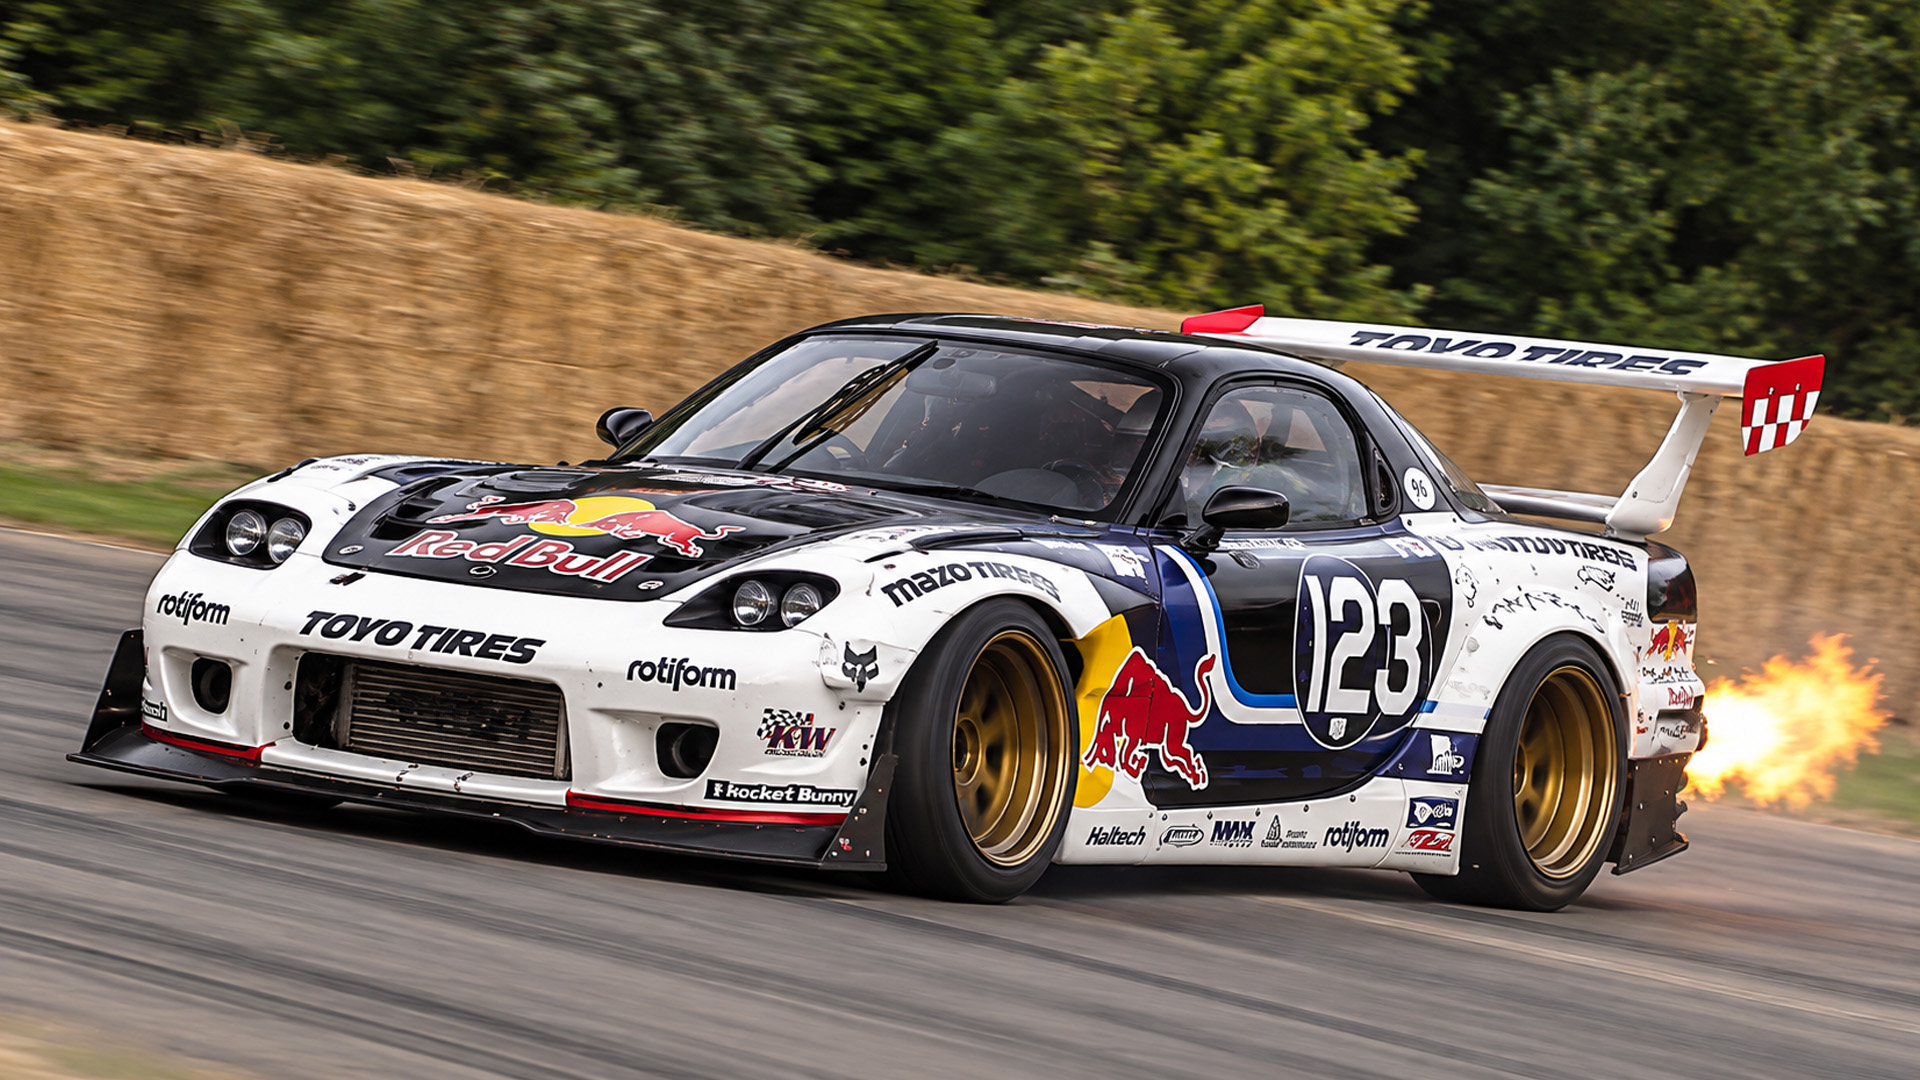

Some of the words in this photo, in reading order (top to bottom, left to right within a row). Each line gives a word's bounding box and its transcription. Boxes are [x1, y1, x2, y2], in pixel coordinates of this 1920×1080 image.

[1350, 330, 1518, 358] TOYO
[1520, 345, 1709, 376] TIRES
[1411, 478, 1428, 498] 96
[387, 530, 536, 563] Red
[506, 540, 653, 583] Bull
[156, 591, 230, 626] rotiform
[299, 610, 413, 646] TOYO
[411, 624, 547, 664] TIRES
[1304, 575, 1422, 715] 123
[626, 657, 737, 691] rotiform
[767, 725, 836, 752] KW
[798, 788, 854, 806] Bunny
[1085, 825, 1146, 846] Haltech
[1323, 820, 1389, 853] rotiform
